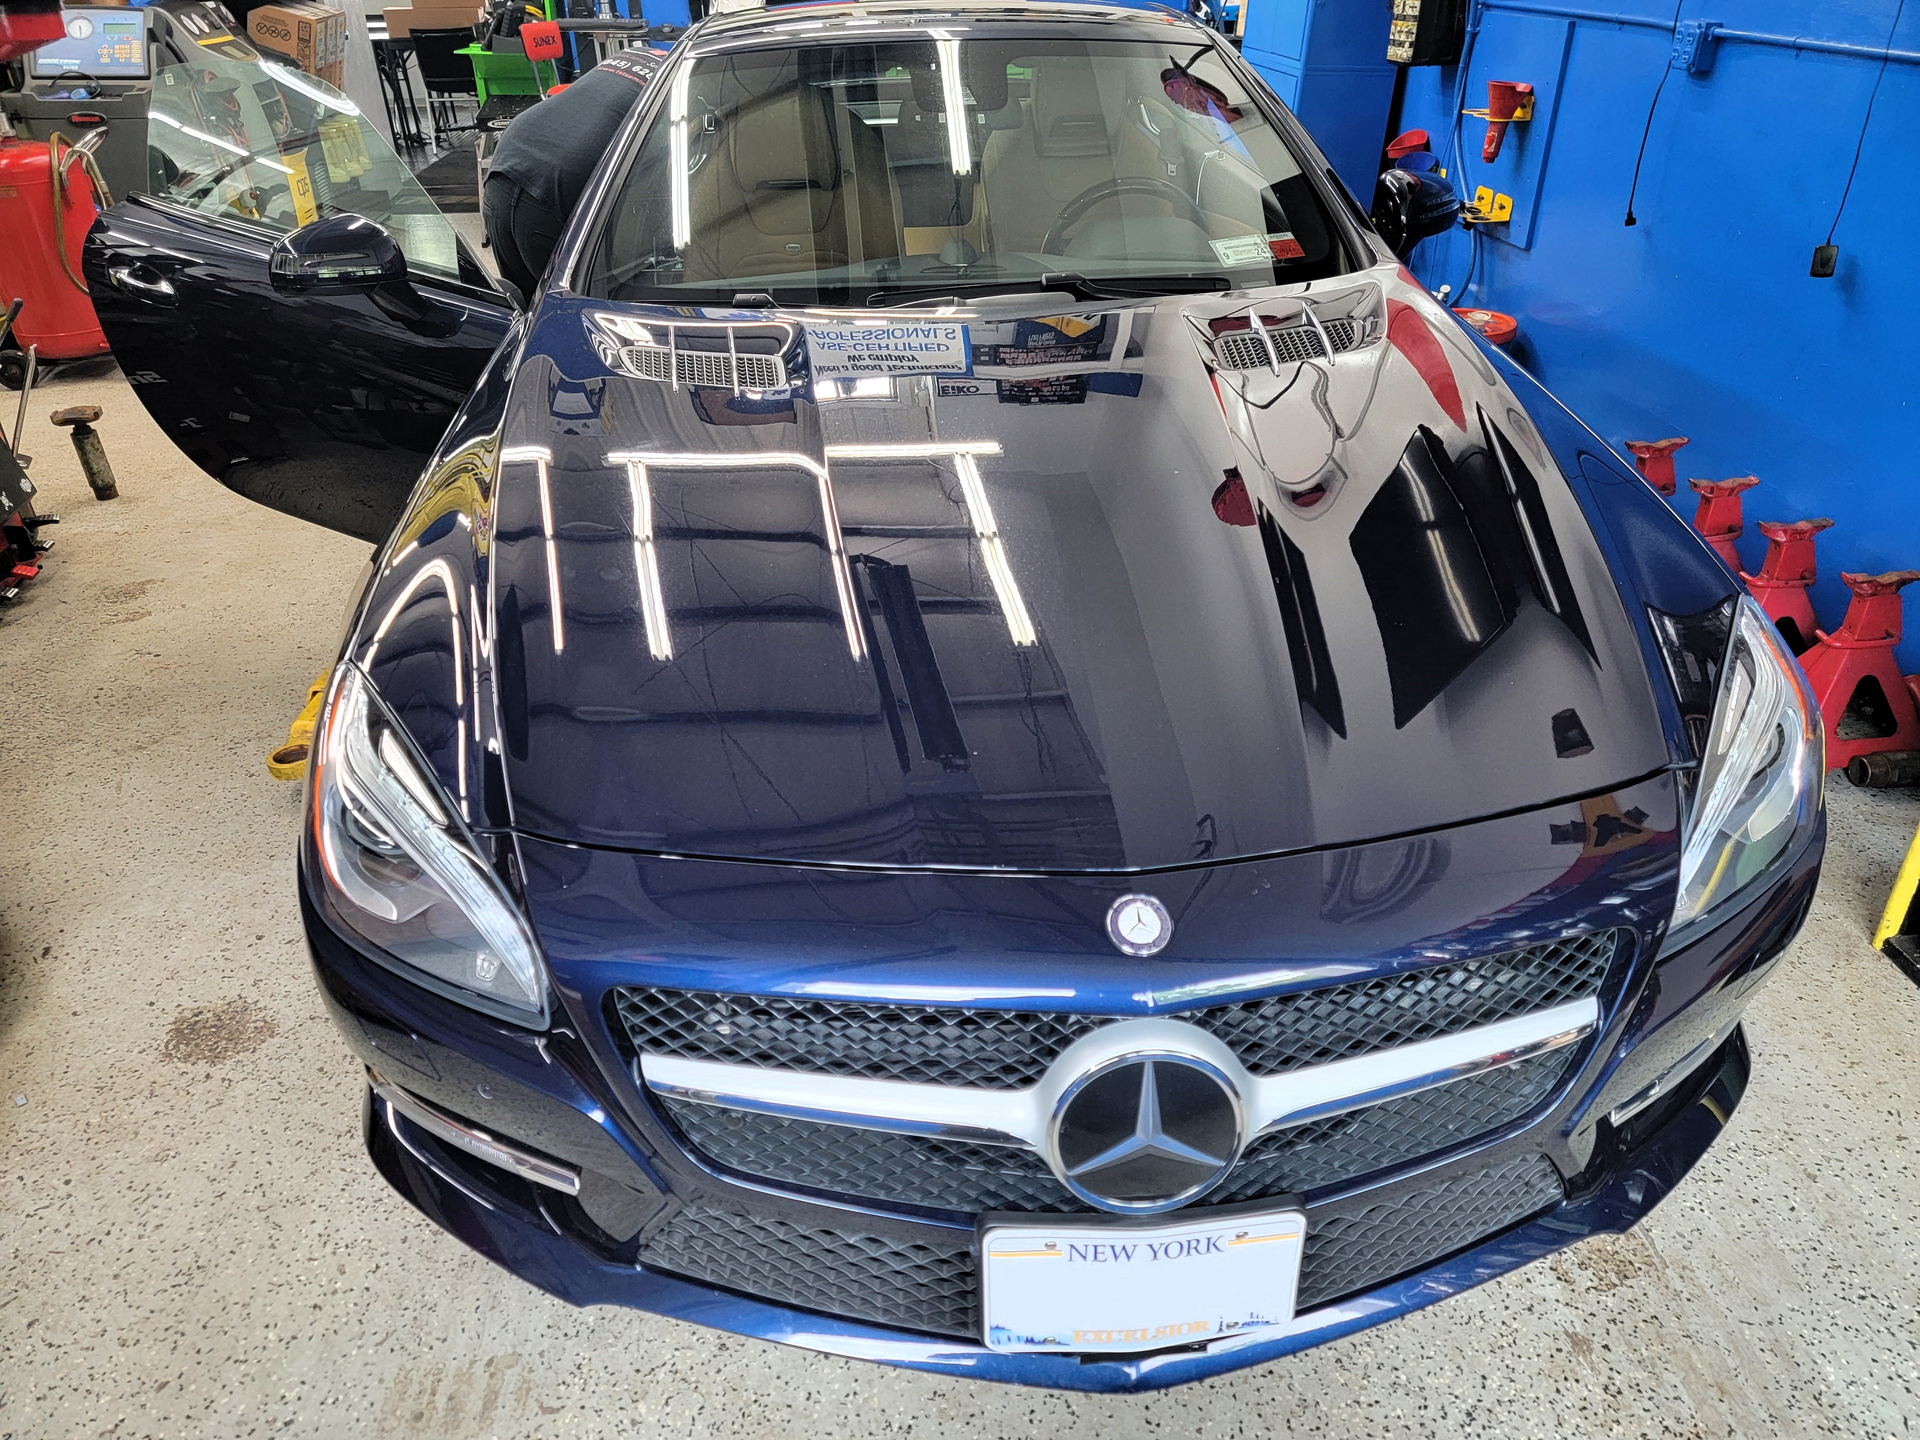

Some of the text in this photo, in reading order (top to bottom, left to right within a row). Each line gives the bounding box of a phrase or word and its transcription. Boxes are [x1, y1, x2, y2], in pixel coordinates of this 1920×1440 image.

[533, 35, 558, 48] SUNEX
[1254, 247, 1267, 256] 24
[1067, 1235, 1225, 1263] NEW YORK
[1072, 1320, 1209, 1344] EXCELSIOR
